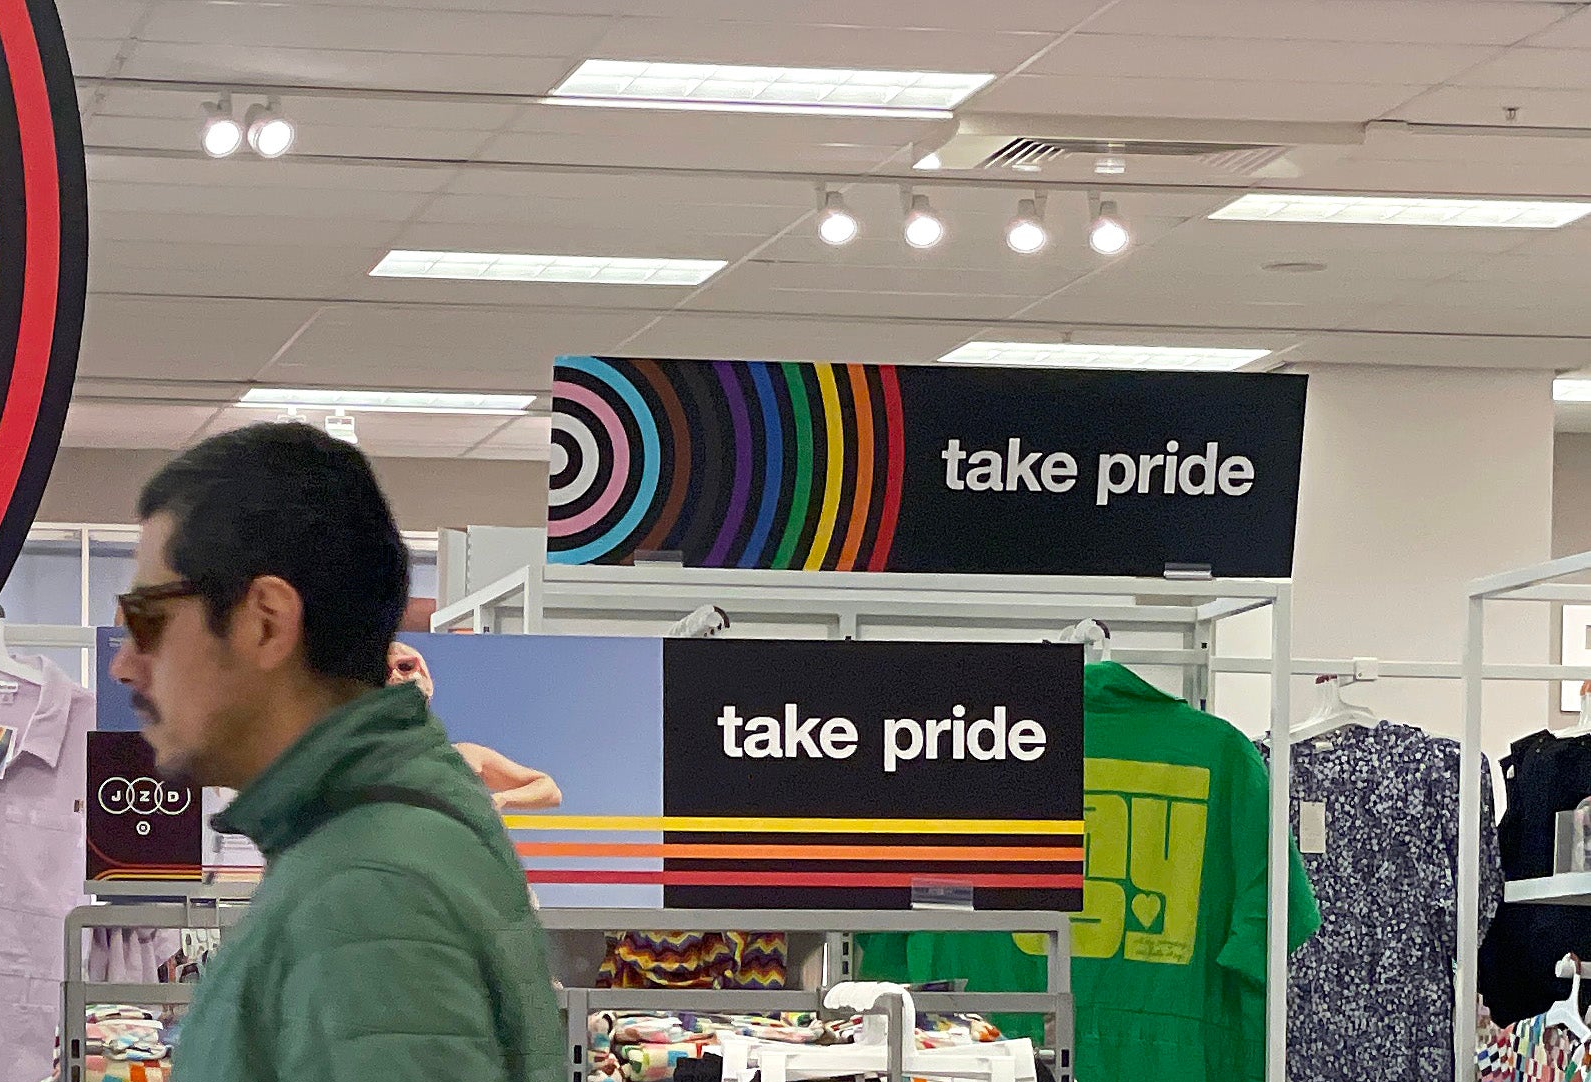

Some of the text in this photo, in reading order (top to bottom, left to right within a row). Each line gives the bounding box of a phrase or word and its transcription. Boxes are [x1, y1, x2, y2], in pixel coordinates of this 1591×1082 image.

[941, 437, 1255, 506] take pride
[717, 703, 1047, 772] take pride
